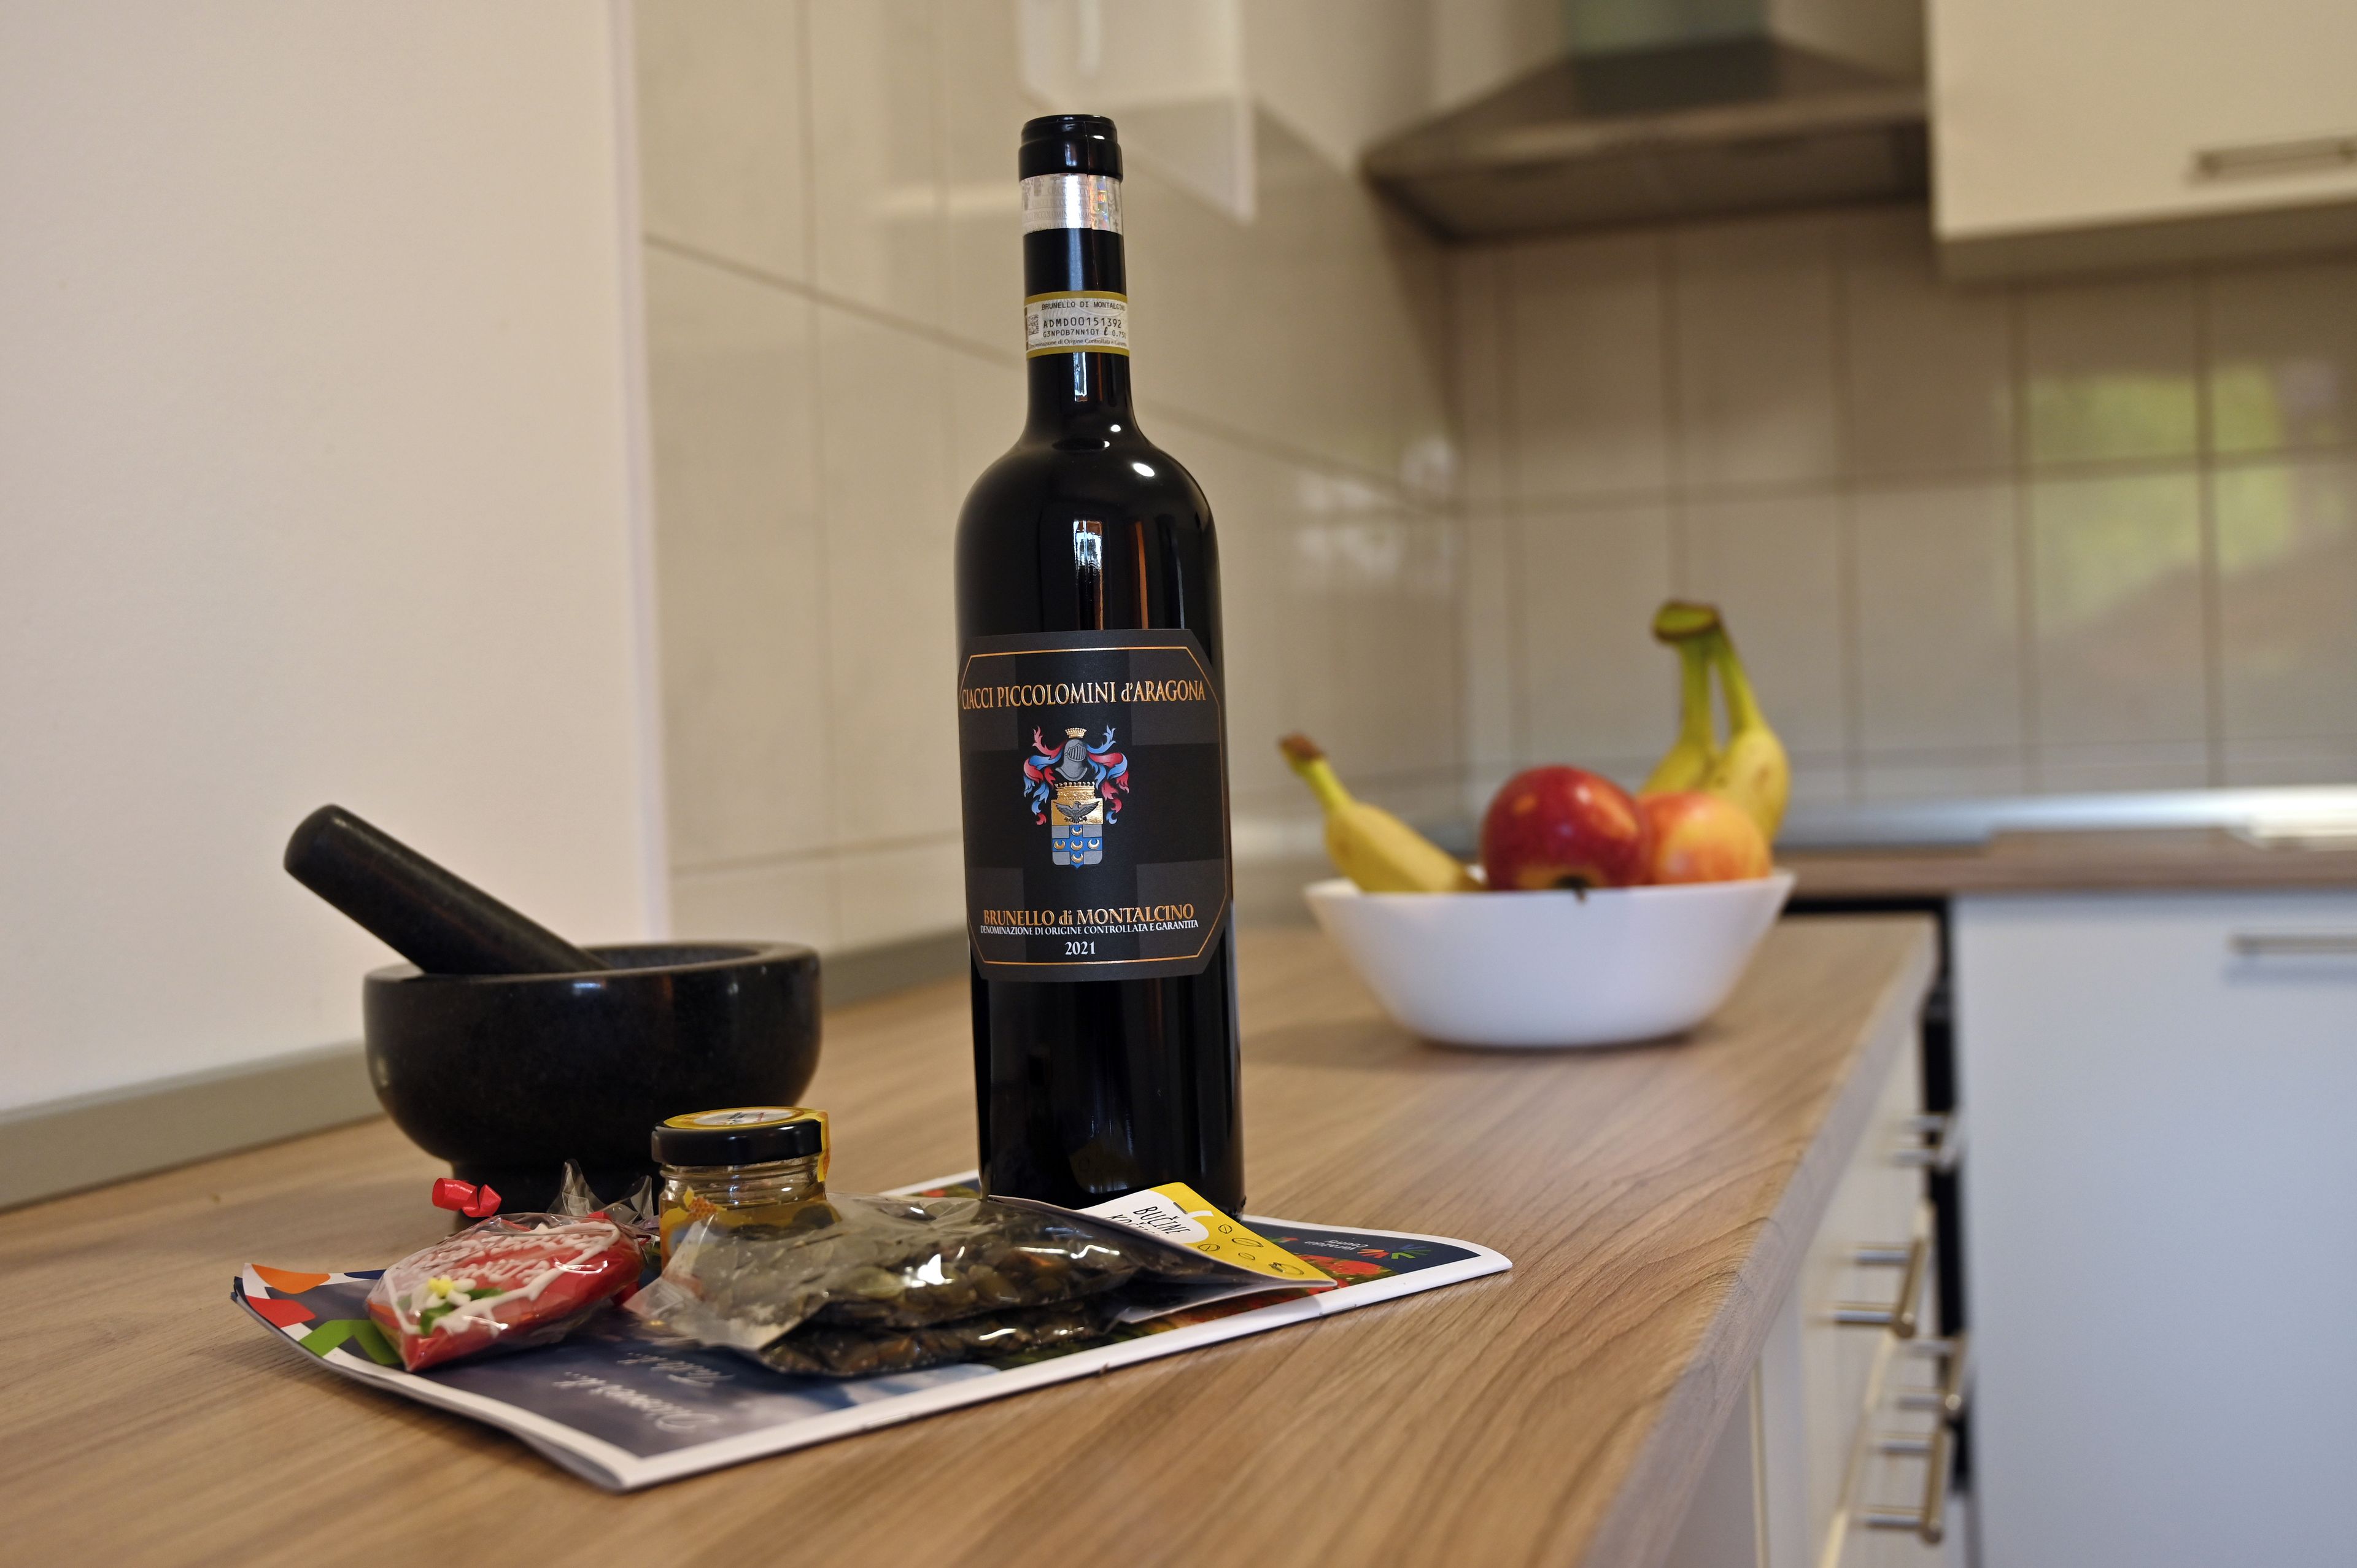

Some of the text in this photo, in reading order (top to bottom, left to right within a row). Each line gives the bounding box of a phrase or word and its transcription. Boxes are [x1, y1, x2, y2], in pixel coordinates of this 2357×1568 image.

[1041, 301, 1075, 311] BRUNELLO
[962, 680, 1206, 709] CIACCI PICCOLOMINI d'ARAGONA
[983, 903, 1194, 926] BRUNELLO di MONTALCINO
[980, 925, 1033, 935] DENOMINAZIONE
[1045, 926, 1082, 935] ORIGINE
[1084, 923, 1148, 934] CONTROLLATA
[1150, 922, 1155, 931] E
[1155, 919, 1199, 931] GARANTITA
[1064, 940, 1096, 956] 2021
[1132, 1206, 1191, 1234] BUČINE
